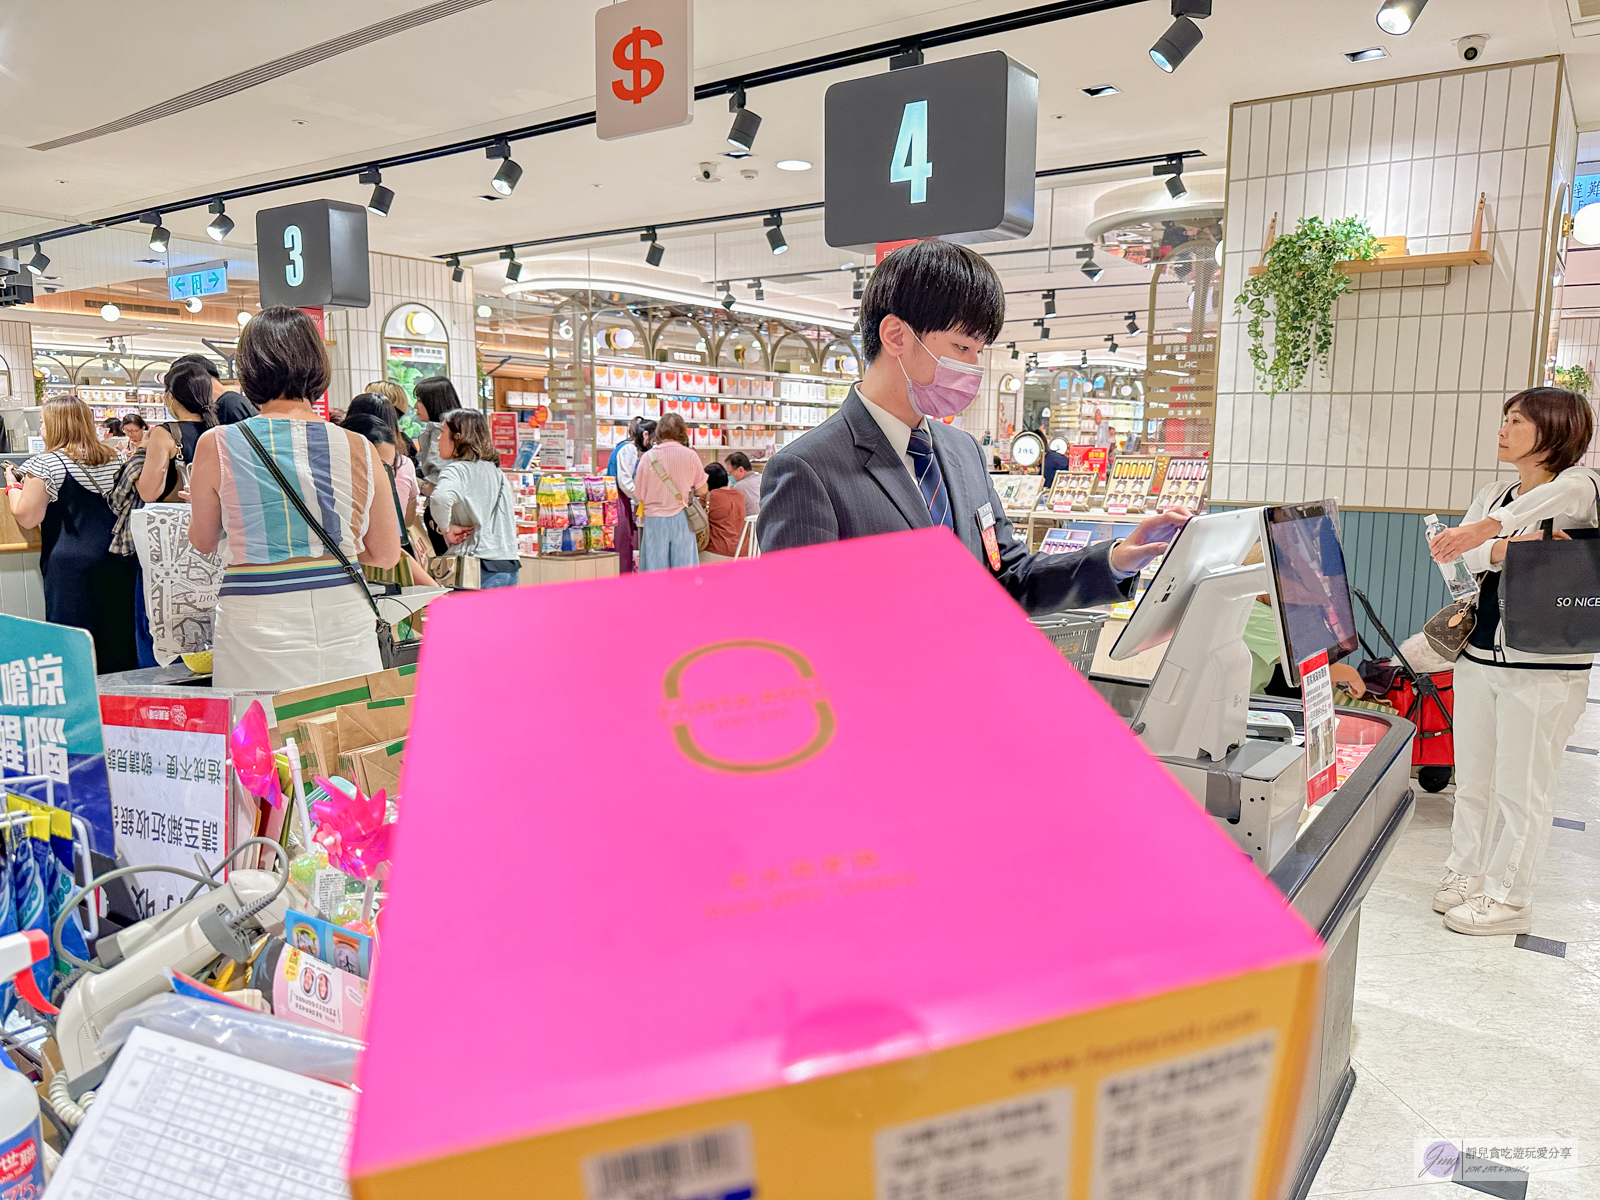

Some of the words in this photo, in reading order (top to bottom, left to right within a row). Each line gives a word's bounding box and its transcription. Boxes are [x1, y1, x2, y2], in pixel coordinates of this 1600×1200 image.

[611, 26, 665, 105] $
[889, 99, 933, 205] 4
[283, 224, 304, 288] 3
[1556, 597, 1571, 607] SO
[1574, 597, 1600, 607] NICE
[0, 653, 66, 706] 嗆涼
